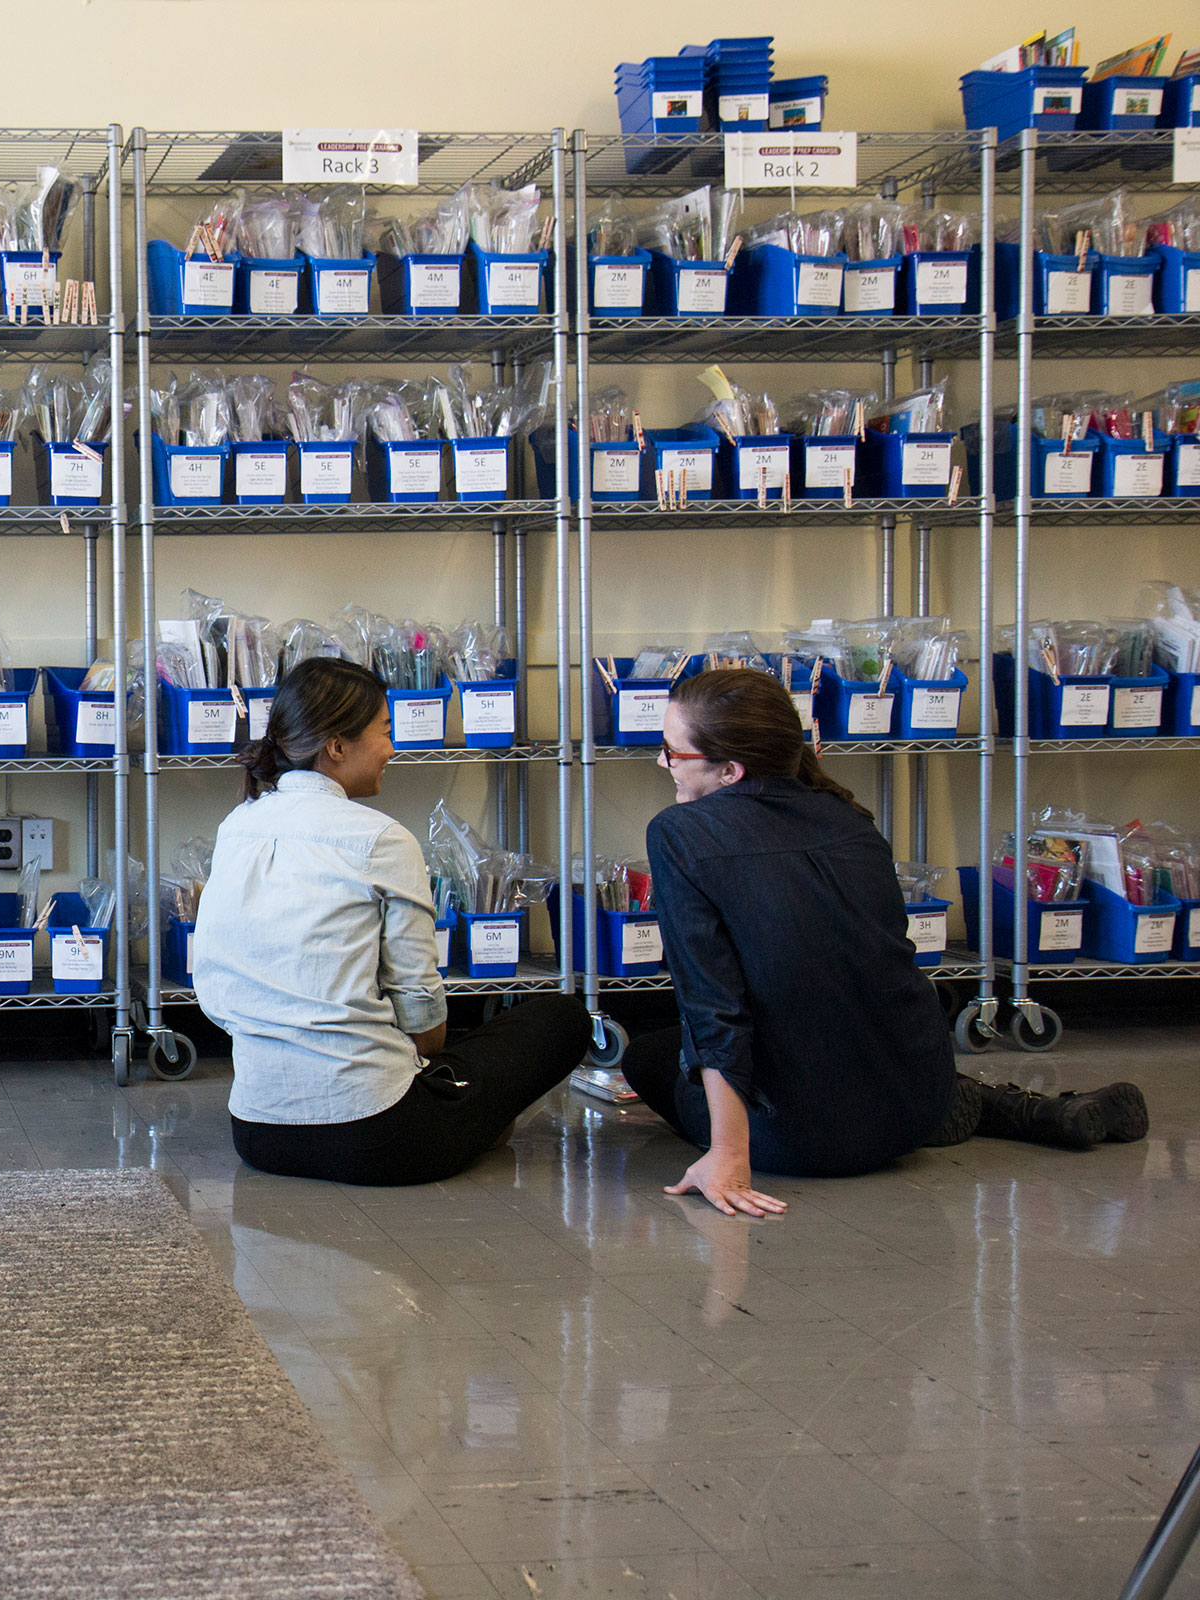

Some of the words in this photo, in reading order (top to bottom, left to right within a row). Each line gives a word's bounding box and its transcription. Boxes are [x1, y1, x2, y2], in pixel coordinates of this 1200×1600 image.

[320, 143, 354, 151] LEADERSHIP
[323, 158, 363, 173] Rack
[370, 158, 379, 174] 3
[764, 161, 804, 177] Rack
[810, 162, 819, 177] 2
[24, 271, 37, 280] 6H
[203, 273, 214, 281] 4E
[428, 273, 443, 281] 4M
[508, 273, 521, 281] 4H
[612, 273, 626, 281] 2M
[814, 272, 828, 280] 2M
[934, 270, 949, 279] 2M
[269, 279, 280, 288] 4E
[337, 279, 352, 287] 4M
[696, 278, 711, 287] 2M
[861, 276, 877, 286] 2M
[756, 455, 771, 464] 2M
[824, 454, 836, 462] 2H
[921, 451, 933, 460] 2H
[255, 462, 265, 470] 5E
[321, 462, 332, 470] 5E
[409, 459, 420, 468] 5E
[475, 458, 486, 467] 5E
[610, 458, 625, 467] 2M
[680, 458, 695, 466] 2M
[71, 463, 83, 471] 7H
[189, 463, 202, 472] 4H
[929, 695, 944, 704] 3M
[481, 700, 494, 709] 5H
[641, 703, 654, 711] 2H
[866, 702, 875, 710] 3E
[96, 711, 108, 720] 8H
[205, 709, 219, 718] 5M
[412, 709, 424, 718] 5H
[920, 921, 931, 930] 3H
[1055, 918, 1069, 927] 2M
[486, 932, 501, 940] 6M
[637, 930, 650, 938] 3M
[0, 950, 14, 959] 9M
